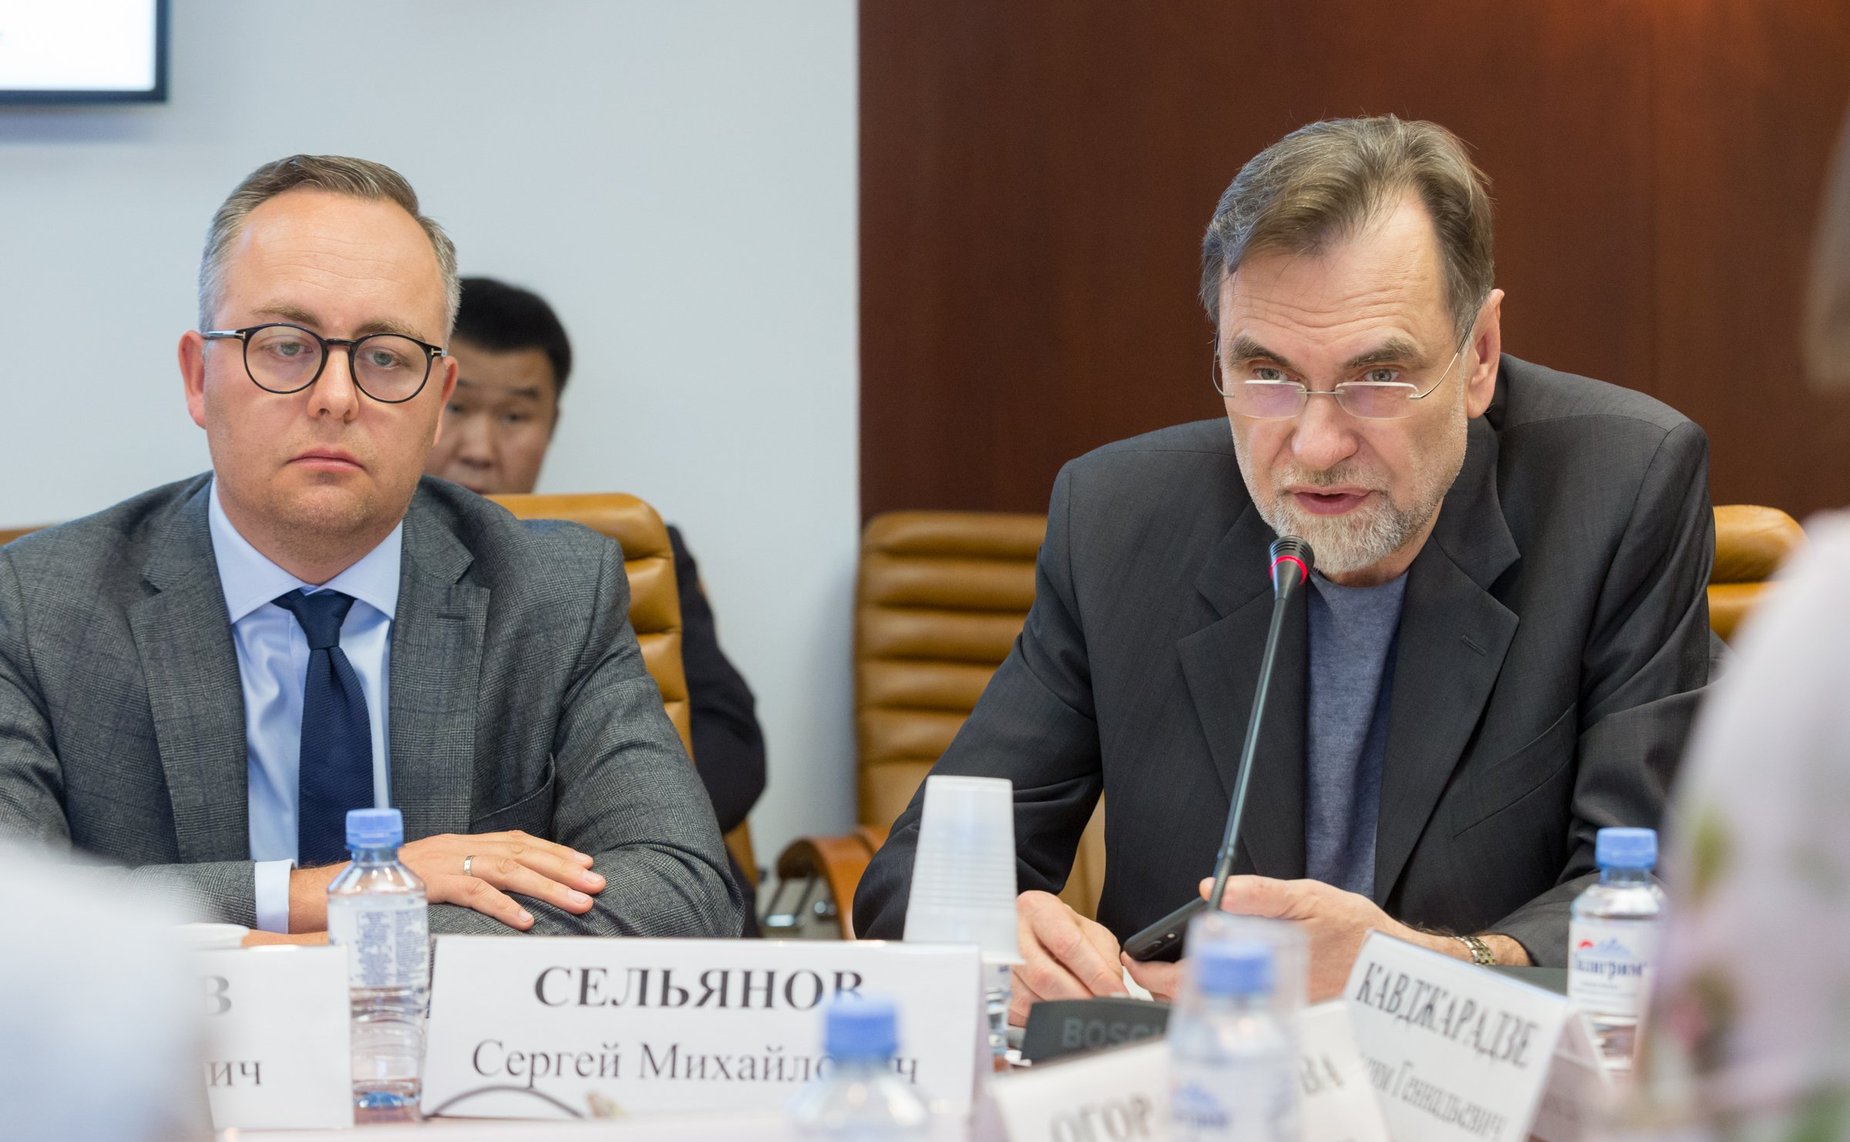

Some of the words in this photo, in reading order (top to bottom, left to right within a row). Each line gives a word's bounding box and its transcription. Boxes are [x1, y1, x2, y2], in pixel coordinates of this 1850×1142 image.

[533, 965, 864, 1010] СЕЛЬЯНОВ
[1355, 961, 1541, 1069] КАВДЖАРАДЗЕ
[472, 1039, 621, 1090] Сергей
[637, 1042, 919, 1084] Михайлоч
